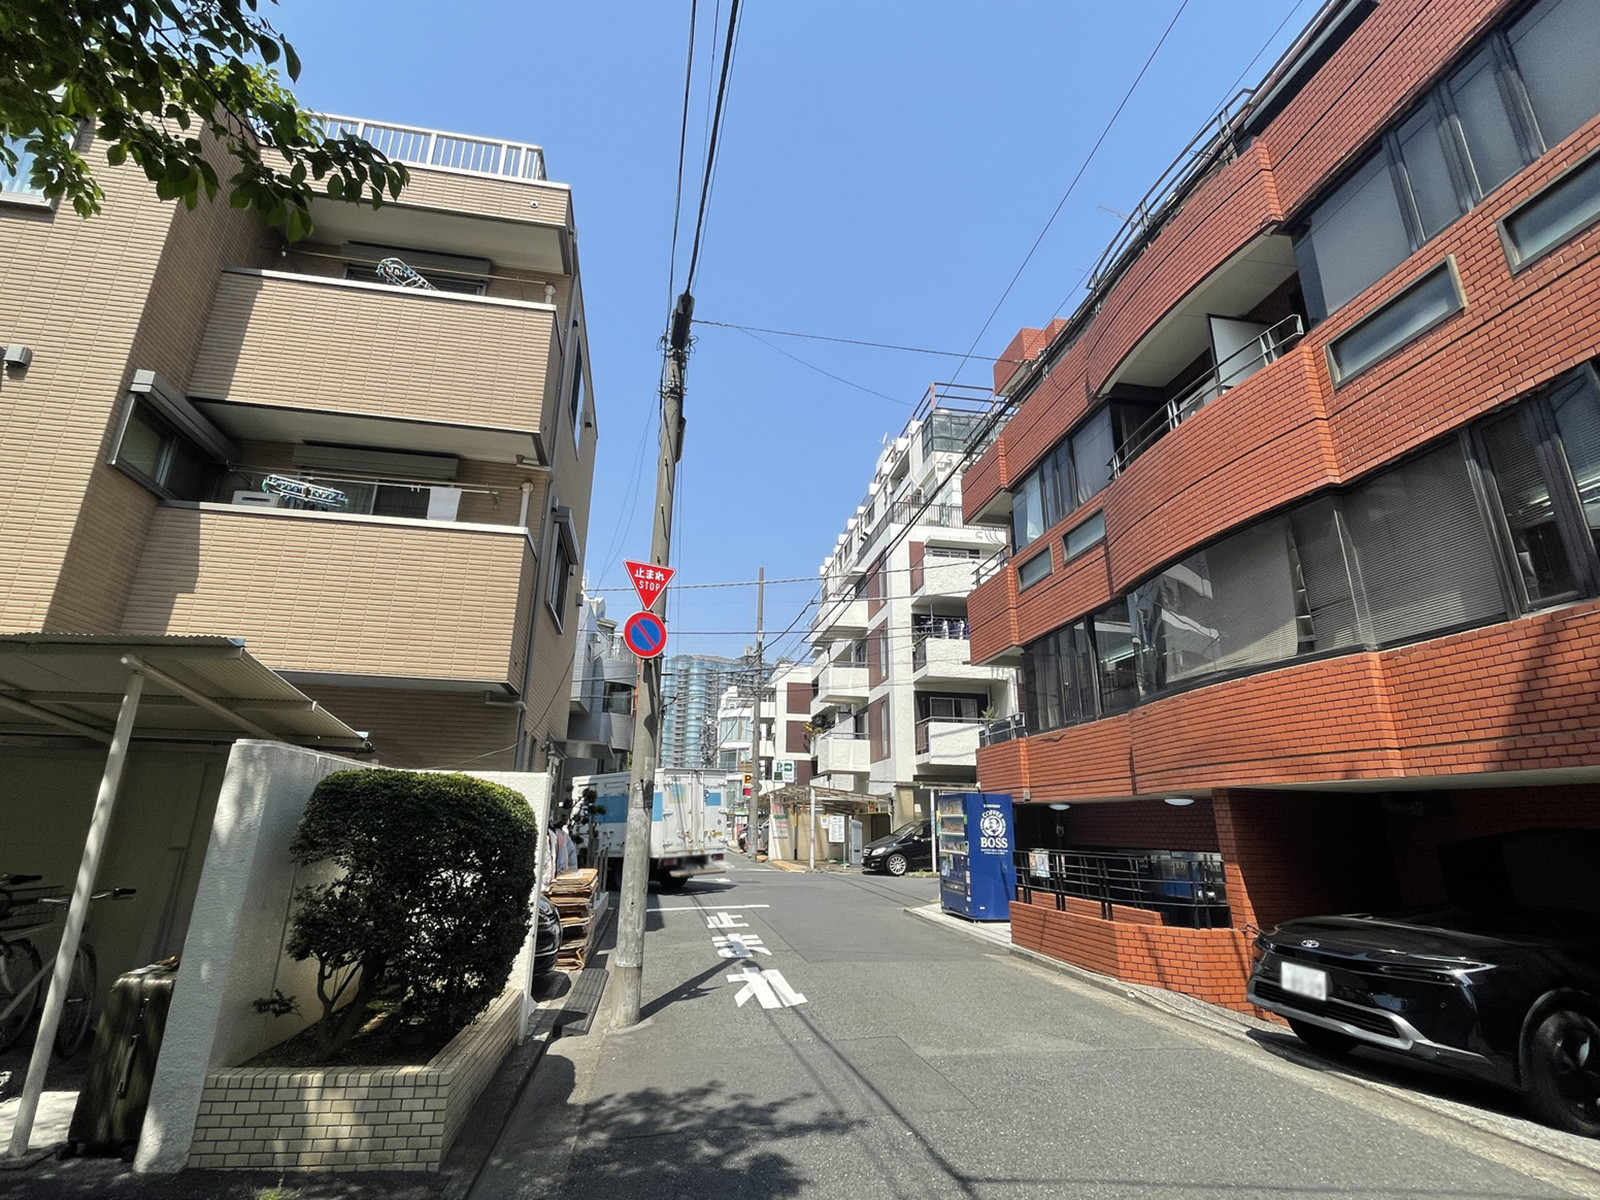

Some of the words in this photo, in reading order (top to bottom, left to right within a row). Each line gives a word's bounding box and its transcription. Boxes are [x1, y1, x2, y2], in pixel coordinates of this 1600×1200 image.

[634, 567, 665, 582] 止まれ
[639, 580, 661, 592] STOP
[980, 837, 1008, 848] BOSS
